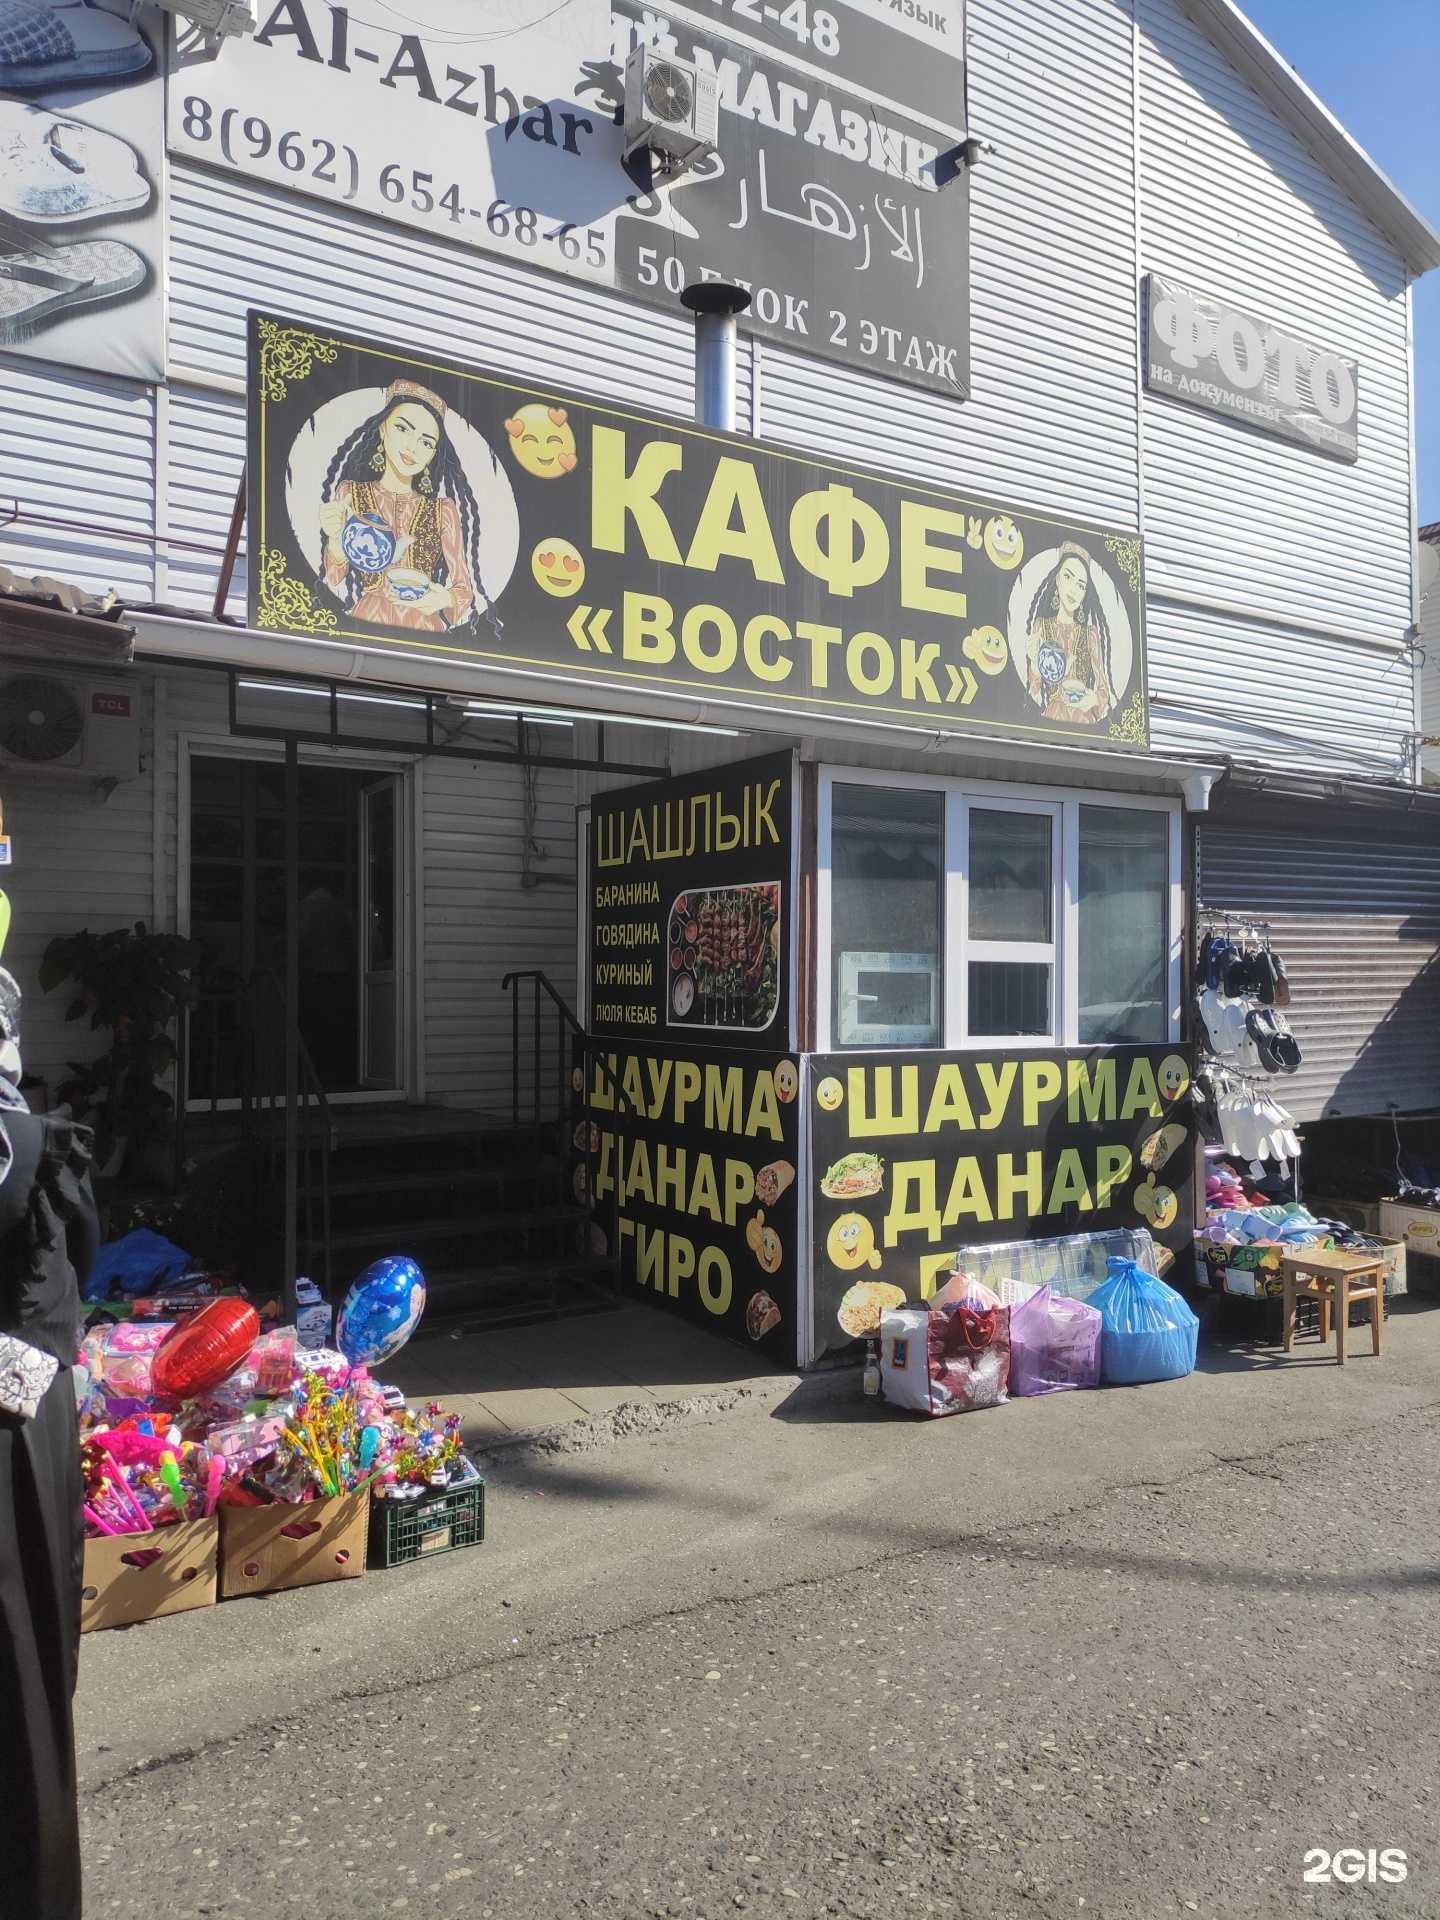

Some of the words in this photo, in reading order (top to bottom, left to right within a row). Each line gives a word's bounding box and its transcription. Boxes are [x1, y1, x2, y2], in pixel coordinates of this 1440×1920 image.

[252, 0, 594, 155] Al-Azhar
[692, 45, 939, 191] МАГАЗИН
[182, 96, 360, 200] 8(962)
[378, 163, 607, 269] 654-68-65
[637, 246, 686, 295] 50
[829, 311, 849, 347] 2
[859, 318, 958, 380] ЭТАЖ
[1152, 293, 1356, 424] ФОТО
[591, 424, 967, 618] КАФЕ
[565, 590, 979, 705] «ВОСТОК»
[597, 779, 781, 867] ШАШЛЫК
[595, 922, 660, 949] ГОВЯДИНА
[596, 880, 660, 908] БАРАНИНА
[595, 1004, 623, 1023] ЛЮЛЯ
[625, 1006, 657, 1025] КЕБАБ
[596, 959, 653, 986] КУРИНЫЙ
[847, 1057, 1164, 1138] ШАУРМА
[596, 1131, 755, 1227] ДАНАР
[884, 1144, 1132, 1248] ДАНАР
[618, 1216, 733, 1316] ГИРО
